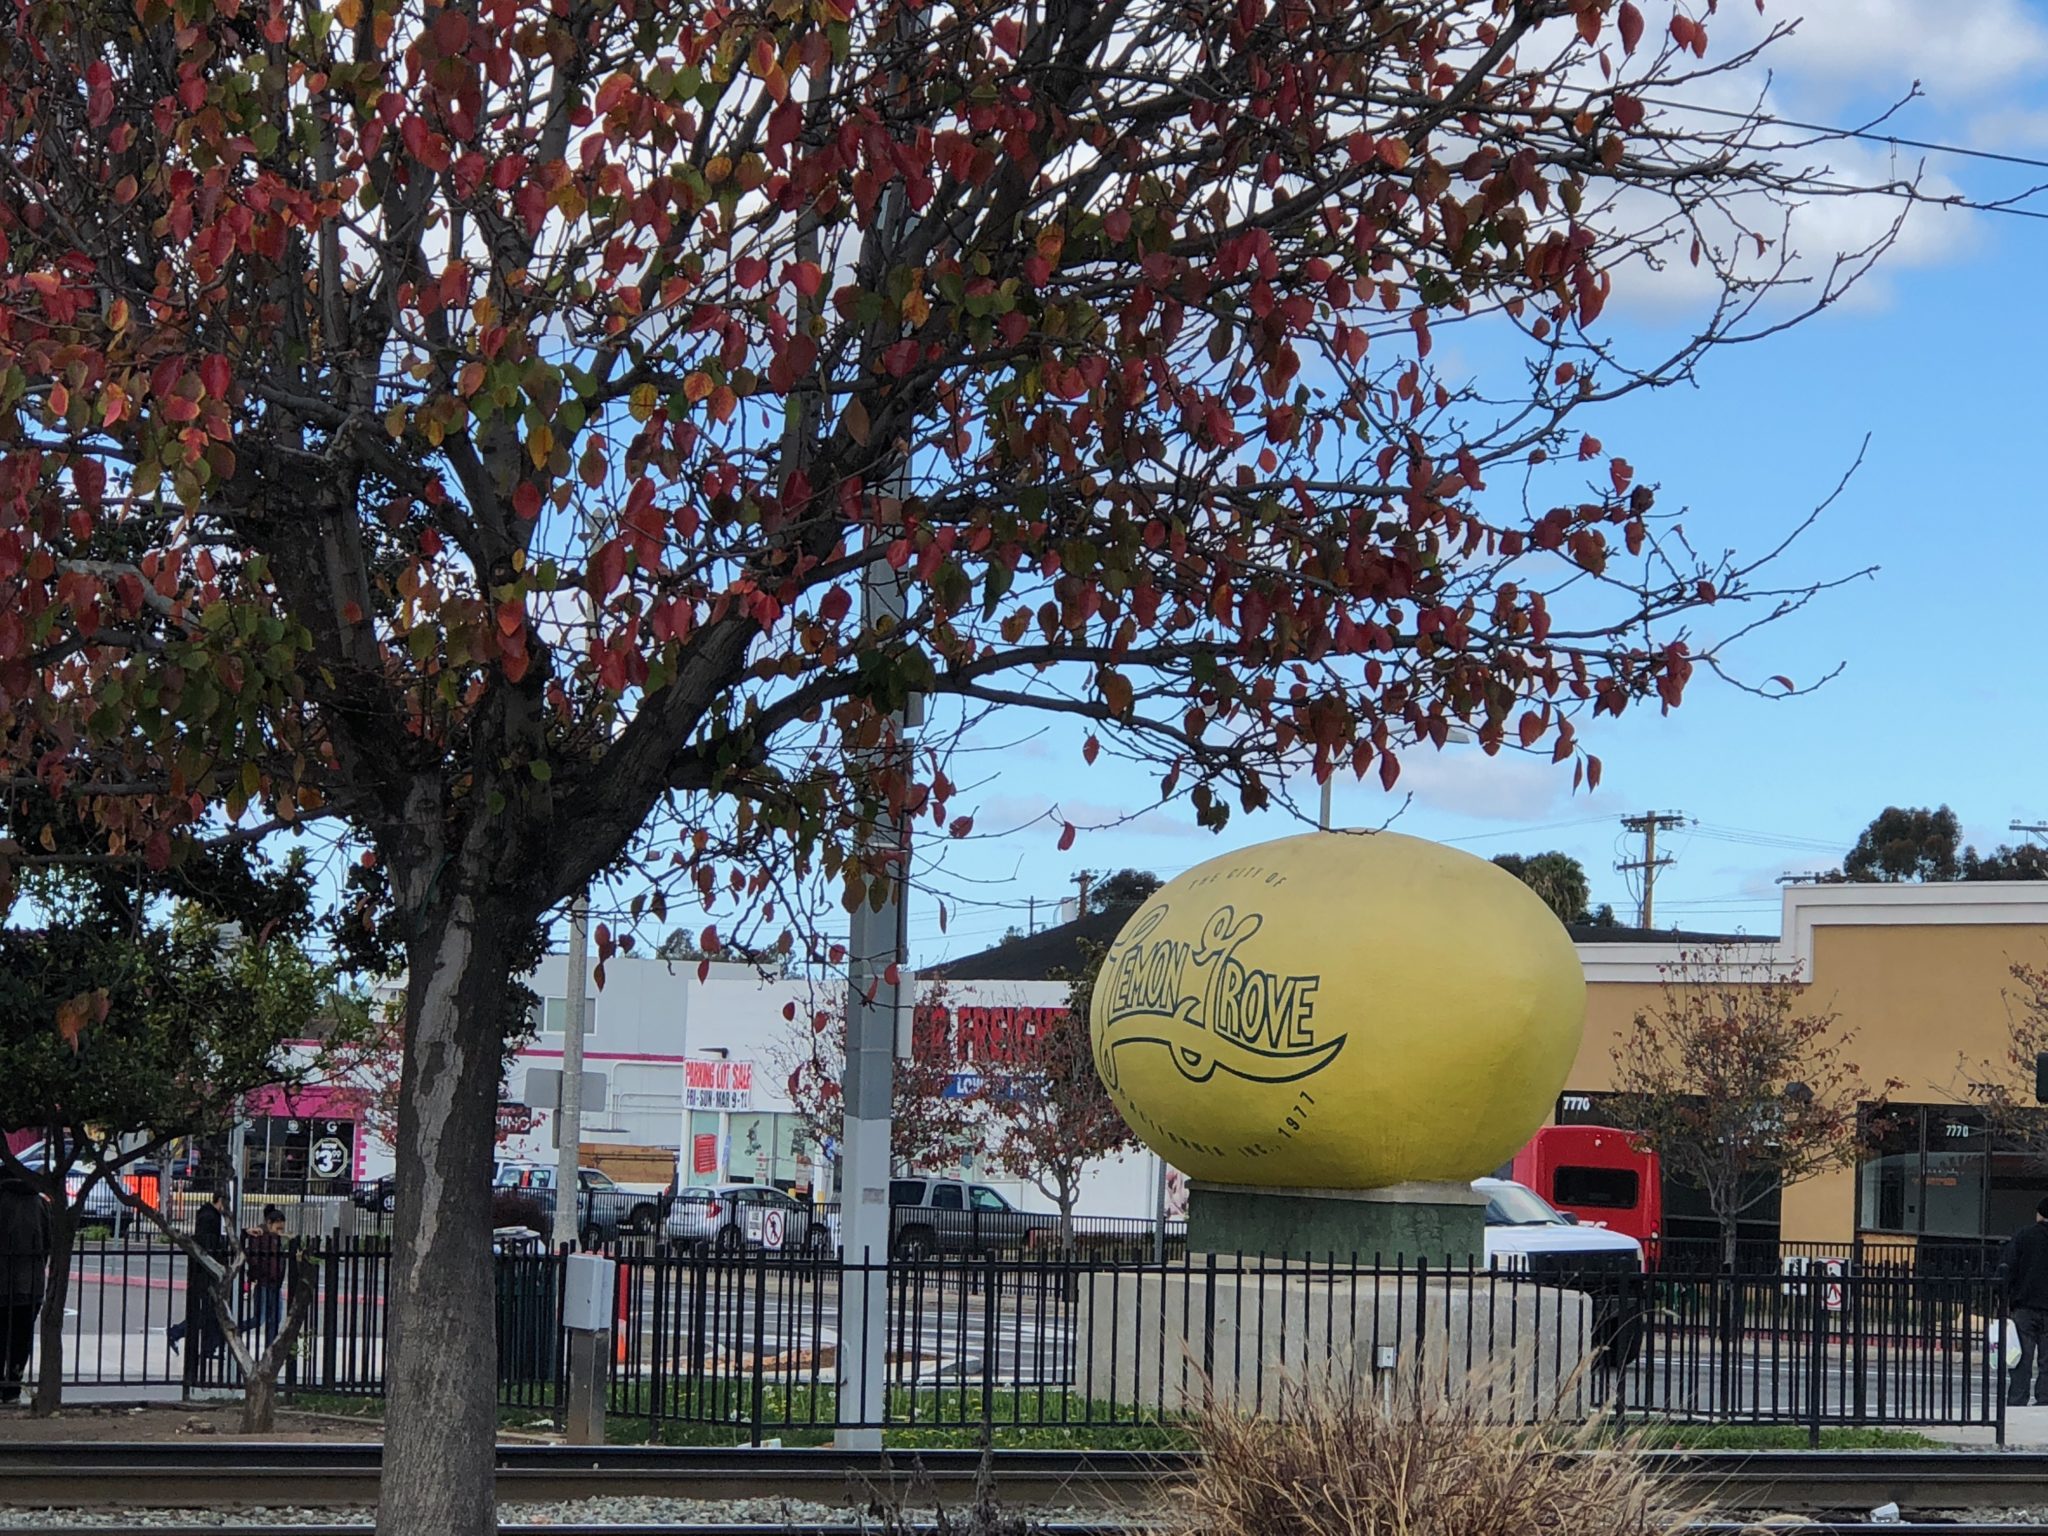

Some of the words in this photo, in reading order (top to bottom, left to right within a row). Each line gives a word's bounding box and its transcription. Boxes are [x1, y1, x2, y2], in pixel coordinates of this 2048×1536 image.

[1265, 871, 1288, 888] OF
[1191, 904, 1321, 1058] GROVE
[685, 1061, 715, 1090] PARKING
[716, 1063, 731, 1090] LOT
[732, 1063, 752, 1091] SALE
[1277, 1090, 1316, 1140] 1977
[1562, 1096, 1591, 1112] 7770
[1945, 1124, 1970, 1138] 7770
